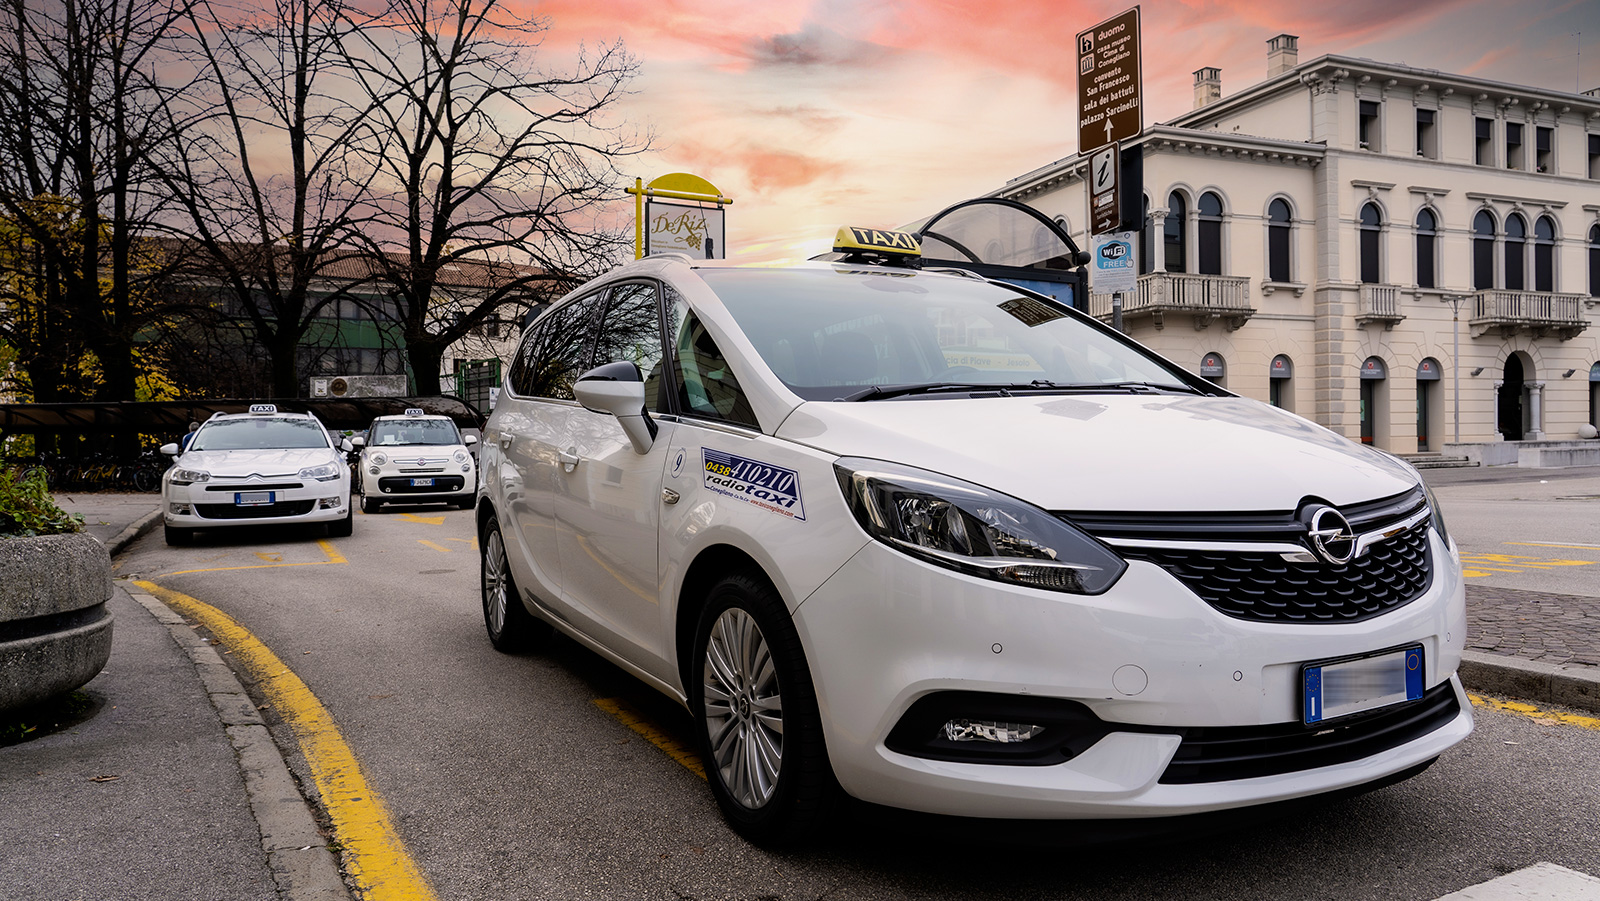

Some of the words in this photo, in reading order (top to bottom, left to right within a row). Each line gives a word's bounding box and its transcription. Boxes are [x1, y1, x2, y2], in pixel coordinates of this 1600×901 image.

[1098, 23, 1126, 41] duomo
[1097, 44, 1110, 54] casa
[1111, 35, 1131, 47] museo
[1103, 48, 1118, 58] Cima
[1119, 44, 1125, 52] di
[1098, 51, 1131, 68] Conegliano
[1094, 67, 1122, 84] convento
[1086, 87, 1098, 97] San
[1099, 74, 1130, 91] Francesco
[1083, 100, 1098, 112] sala
[1099, 94, 1109, 105] dei
[1110, 84, 1134, 101] battuti
[1080, 112, 1105, 128] palazzo
[1105, 97, 1138, 117] Sarcinelli
[852, 228, 916, 249] TAXI
[1103, 259, 1125, 268] FREE
[961, 356, 968, 364] di
[970, 357, 991, 366] Piave
[1007, 359, 1030, 367] Jesolo
[674, 454, 683, 472] 9
[705, 461, 731, 476] 0438
[731, 461, 794, 492] 410210
[706, 474, 798, 508] radiotaxi
